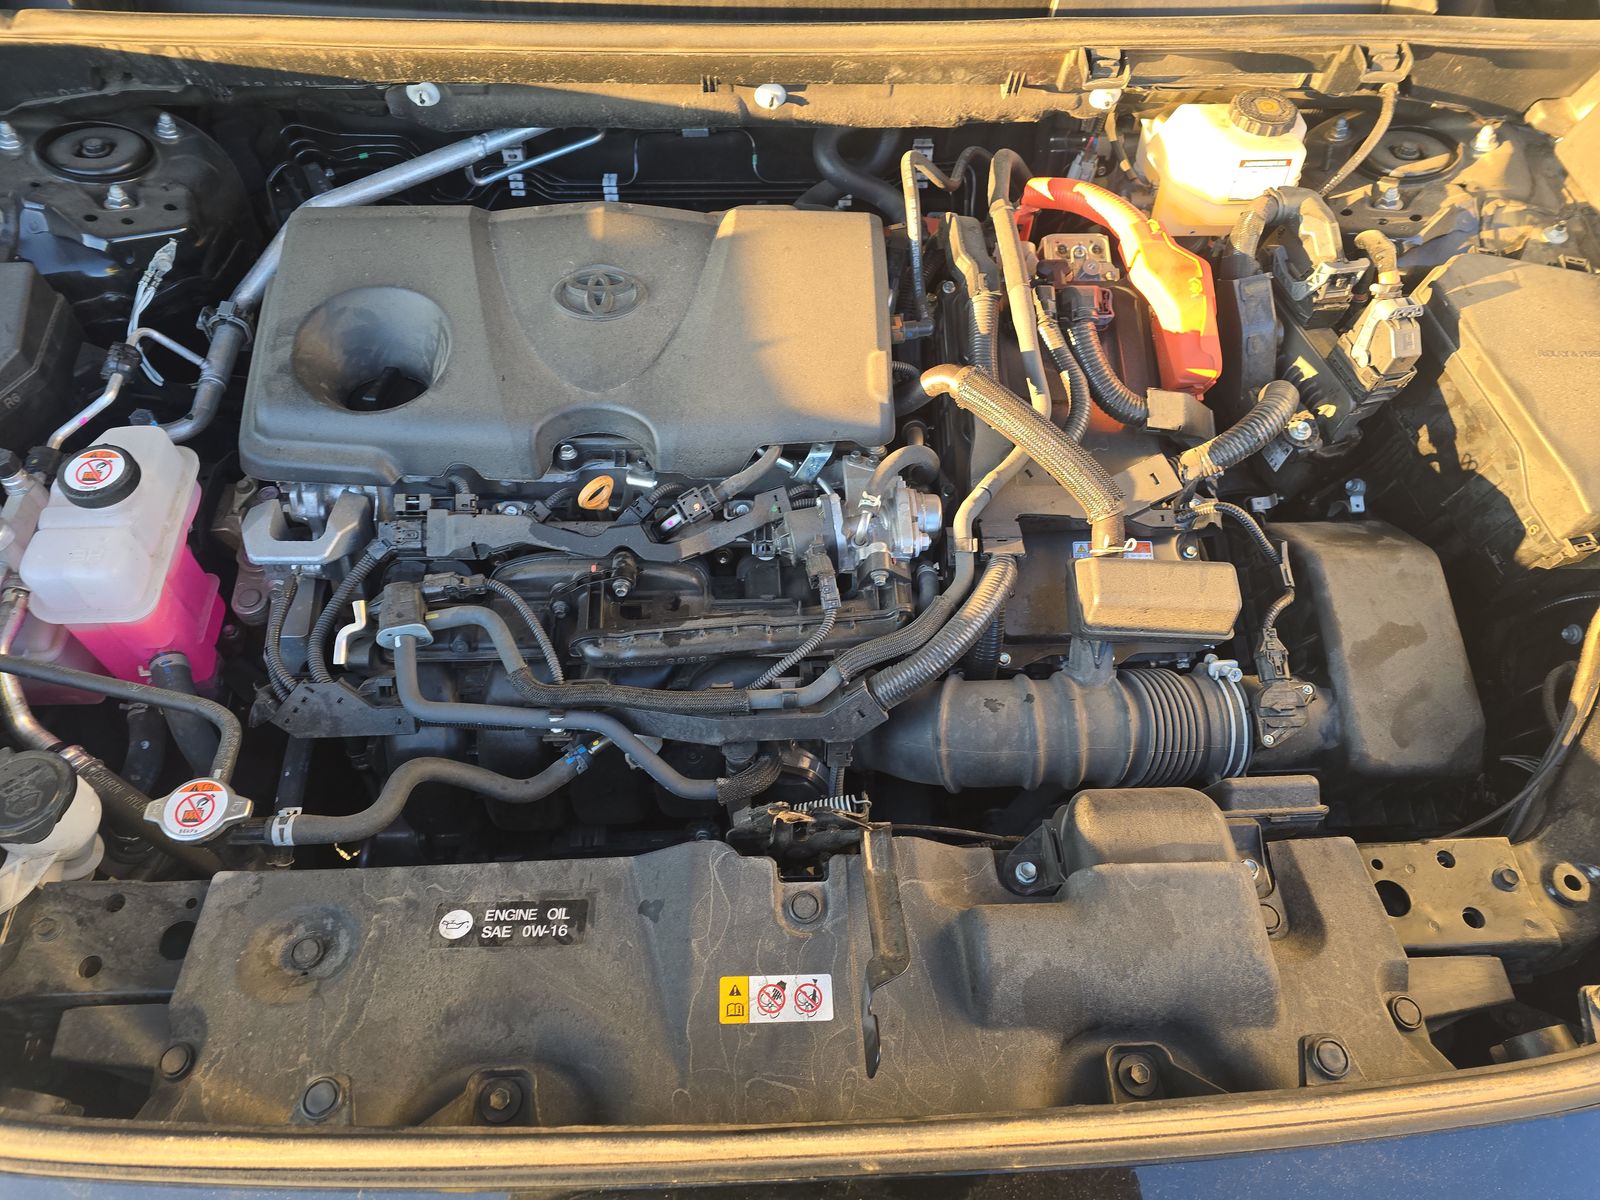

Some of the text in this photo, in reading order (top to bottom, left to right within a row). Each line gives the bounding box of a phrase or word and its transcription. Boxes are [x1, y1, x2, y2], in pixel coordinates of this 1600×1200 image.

[484, 907, 571, 922] ENGINE OIL
[480, 924, 569, 939] SAE 0W-16
